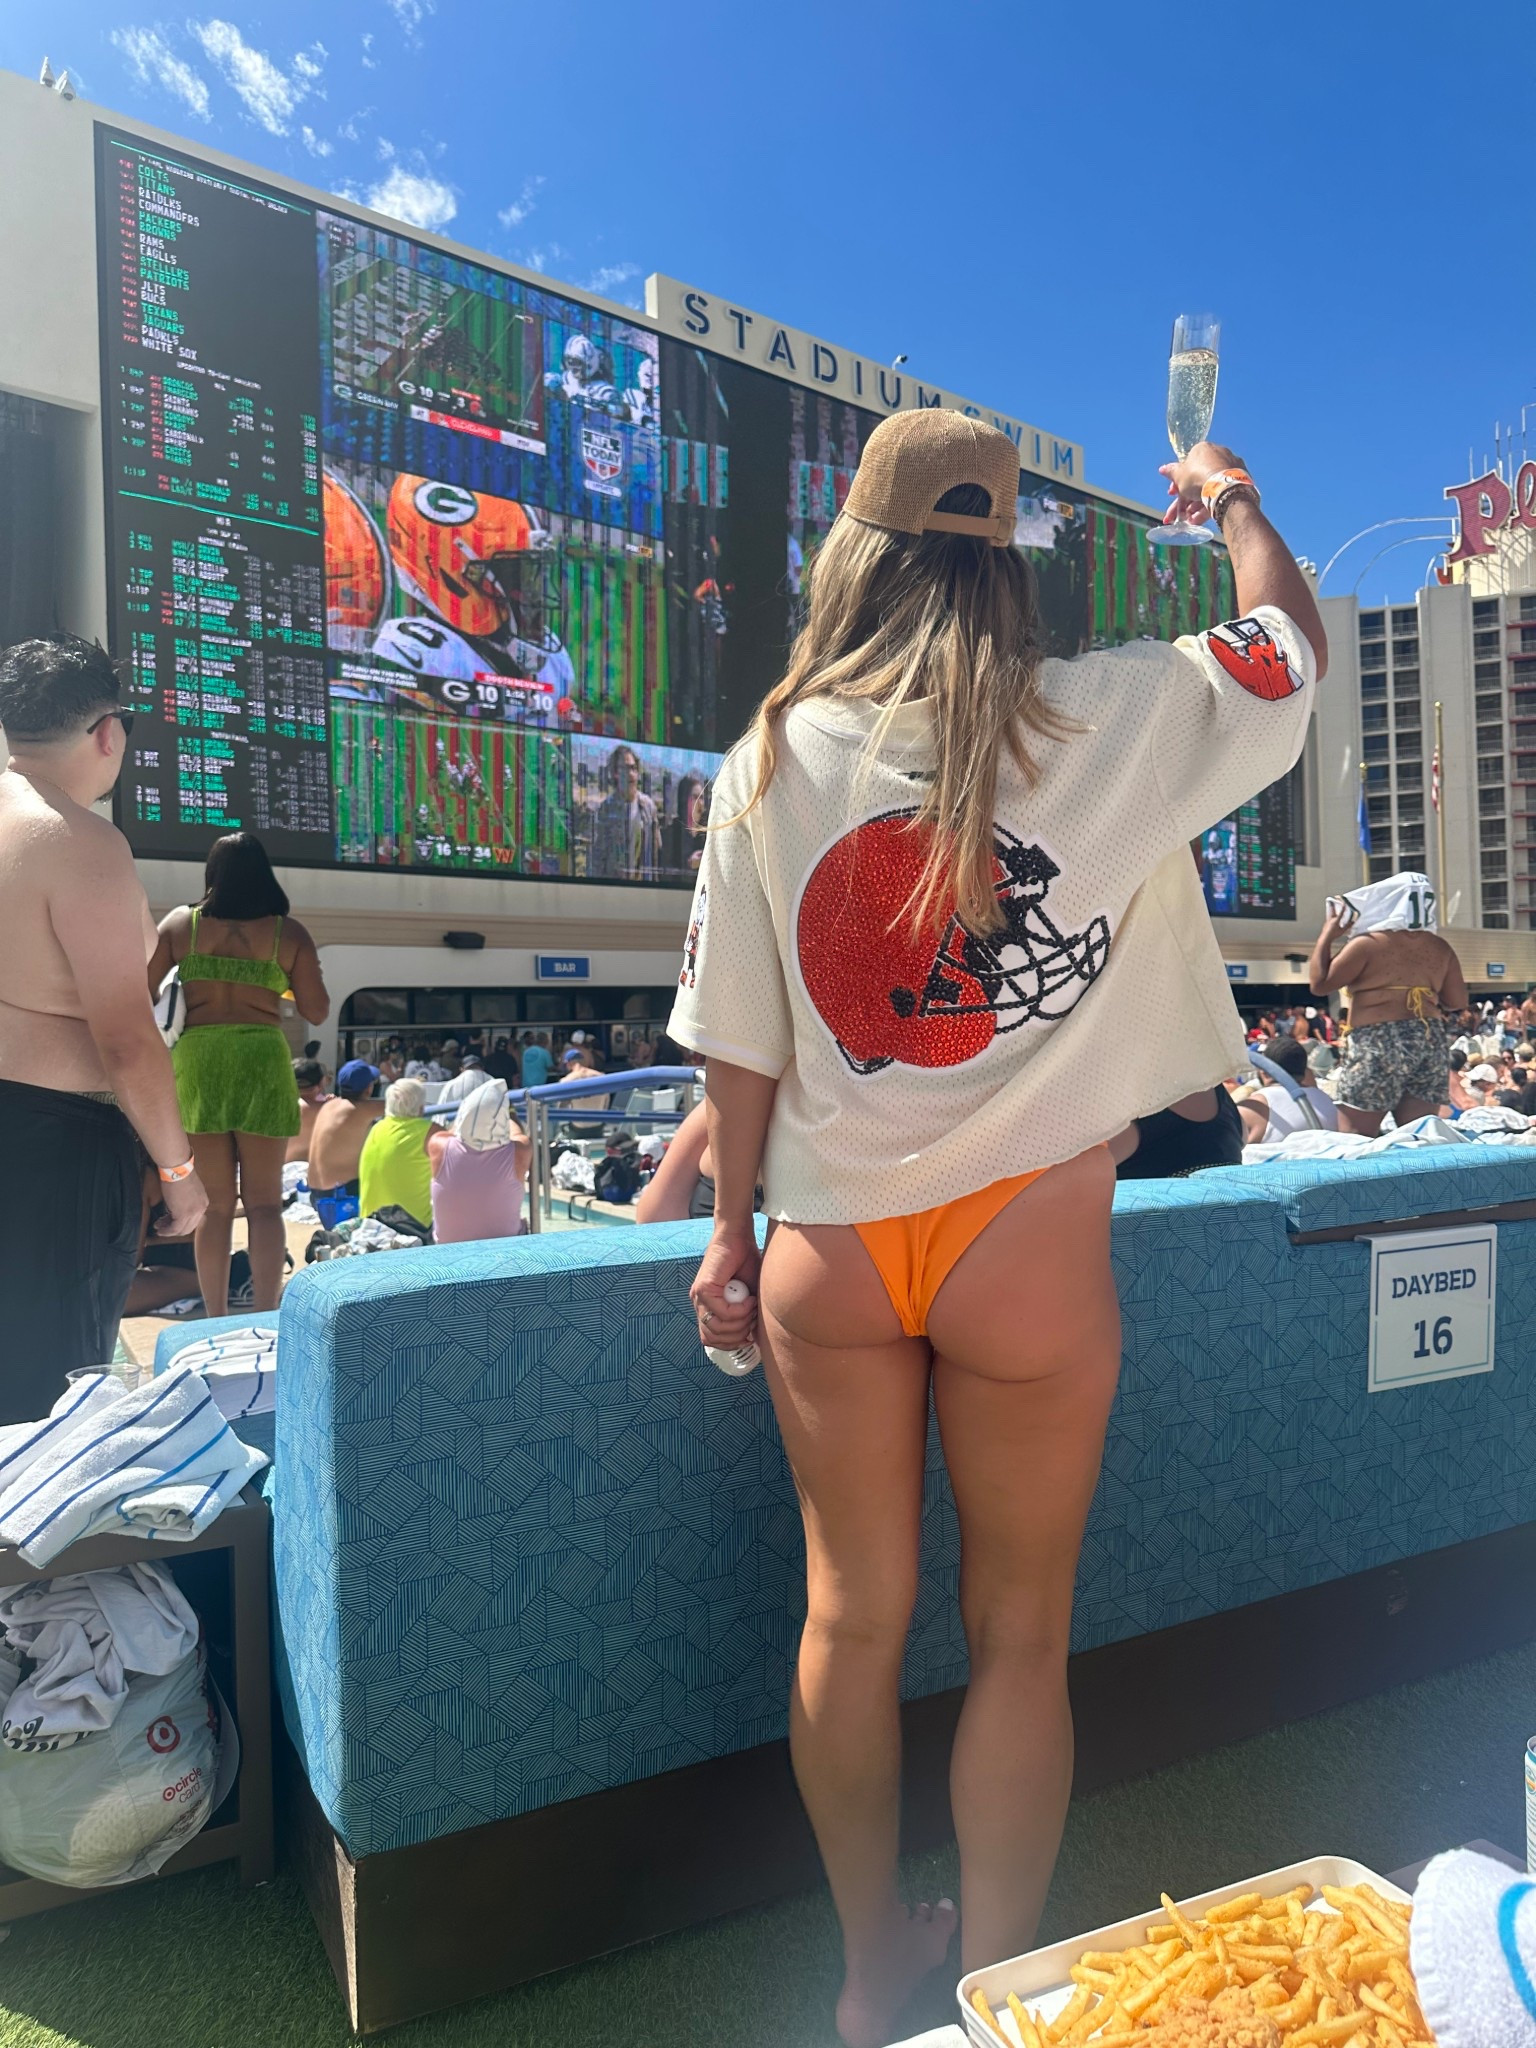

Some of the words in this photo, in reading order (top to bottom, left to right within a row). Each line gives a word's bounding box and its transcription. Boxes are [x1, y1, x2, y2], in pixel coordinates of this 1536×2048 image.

[138, 164, 170, 183] COLTS
[138, 174, 176, 196] TITANS
[138, 210, 182, 233] PACKERS
[139, 221, 177, 241] BROWNS
[139, 233, 165, 250] RAMS
[140, 268, 190, 291] PATRIOTS
[141, 302, 179, 321] TEXANS
[142, 313, 185, 334] JAGUARS
[141, 336, 175, 354] WHITE
[179, 346, 198, 361] SOX
[684, 293, 942, 409] STADIUM
[419, 385, 434, 398] 10
[584, 445, 620, 464] TODAY
[476, 684, 499, 704] 10
[532, 693, 554, 711] 10
[435, 842, 452, 857] 16
[474, 846, 492, 859] 34
[553, 961, 577, 973] BAR
[1391, 1268, 1477, 1299] DAYBED
[1413, 1315, 1454, 1359] 16
[175, 1767, 202, 1793] circle
